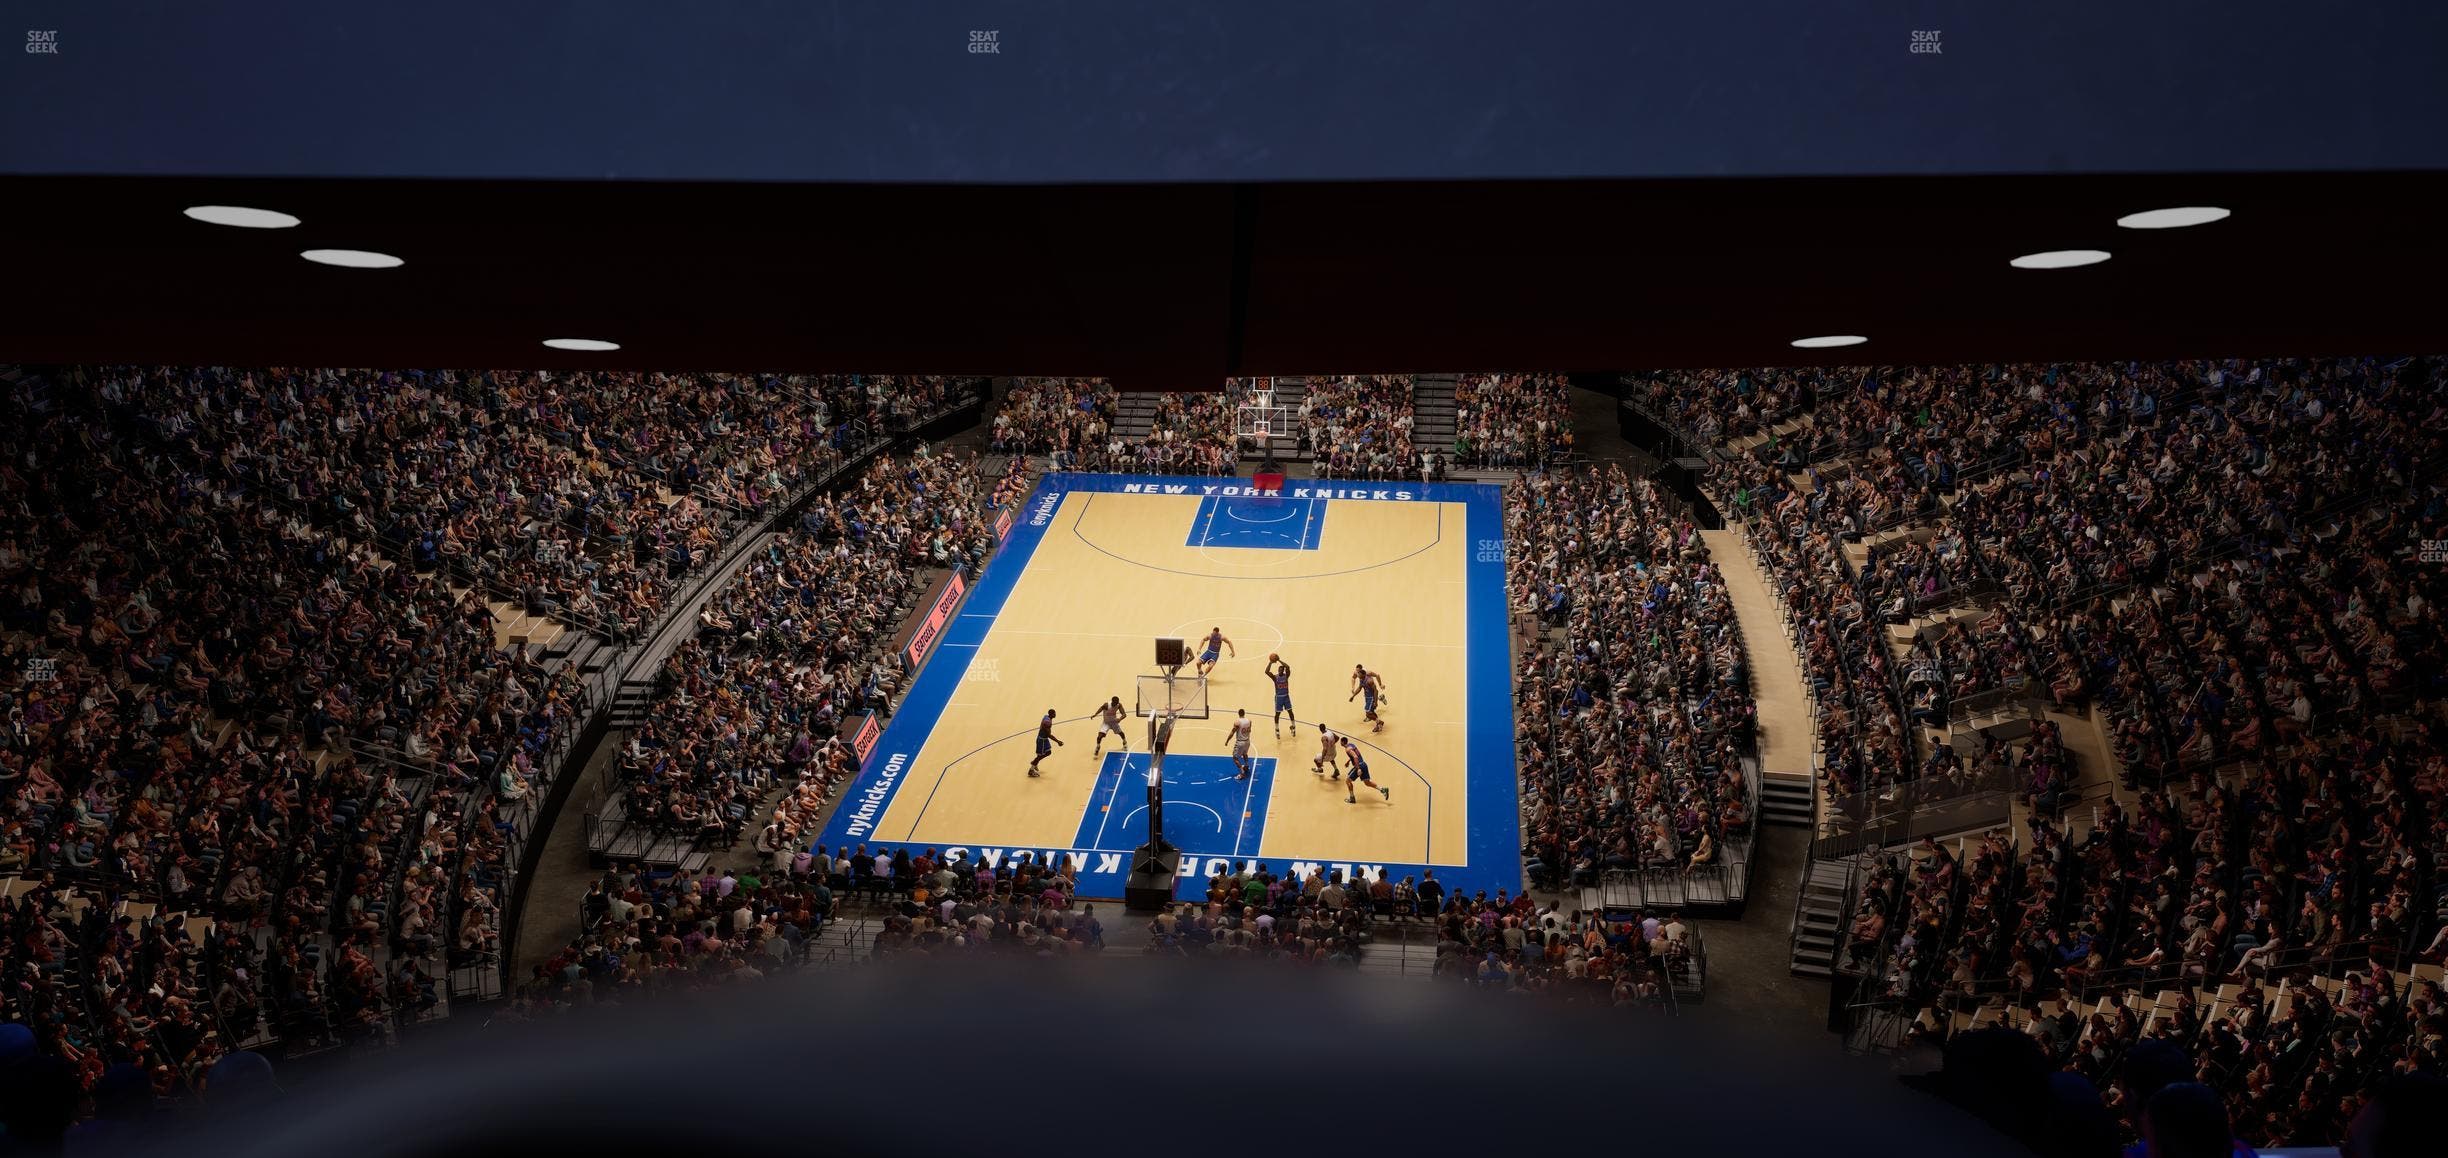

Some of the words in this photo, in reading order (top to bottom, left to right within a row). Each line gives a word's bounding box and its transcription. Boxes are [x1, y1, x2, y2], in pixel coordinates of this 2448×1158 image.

[1123, 483, 1188, 494] NEW
[1202, 485, 1279, 497] YORK
[1294, 487, 1412, 500] KNICKS
[857, 722, 879, 758] SEATGEEK
[846, 753, 908, 836] nyknicks.com
